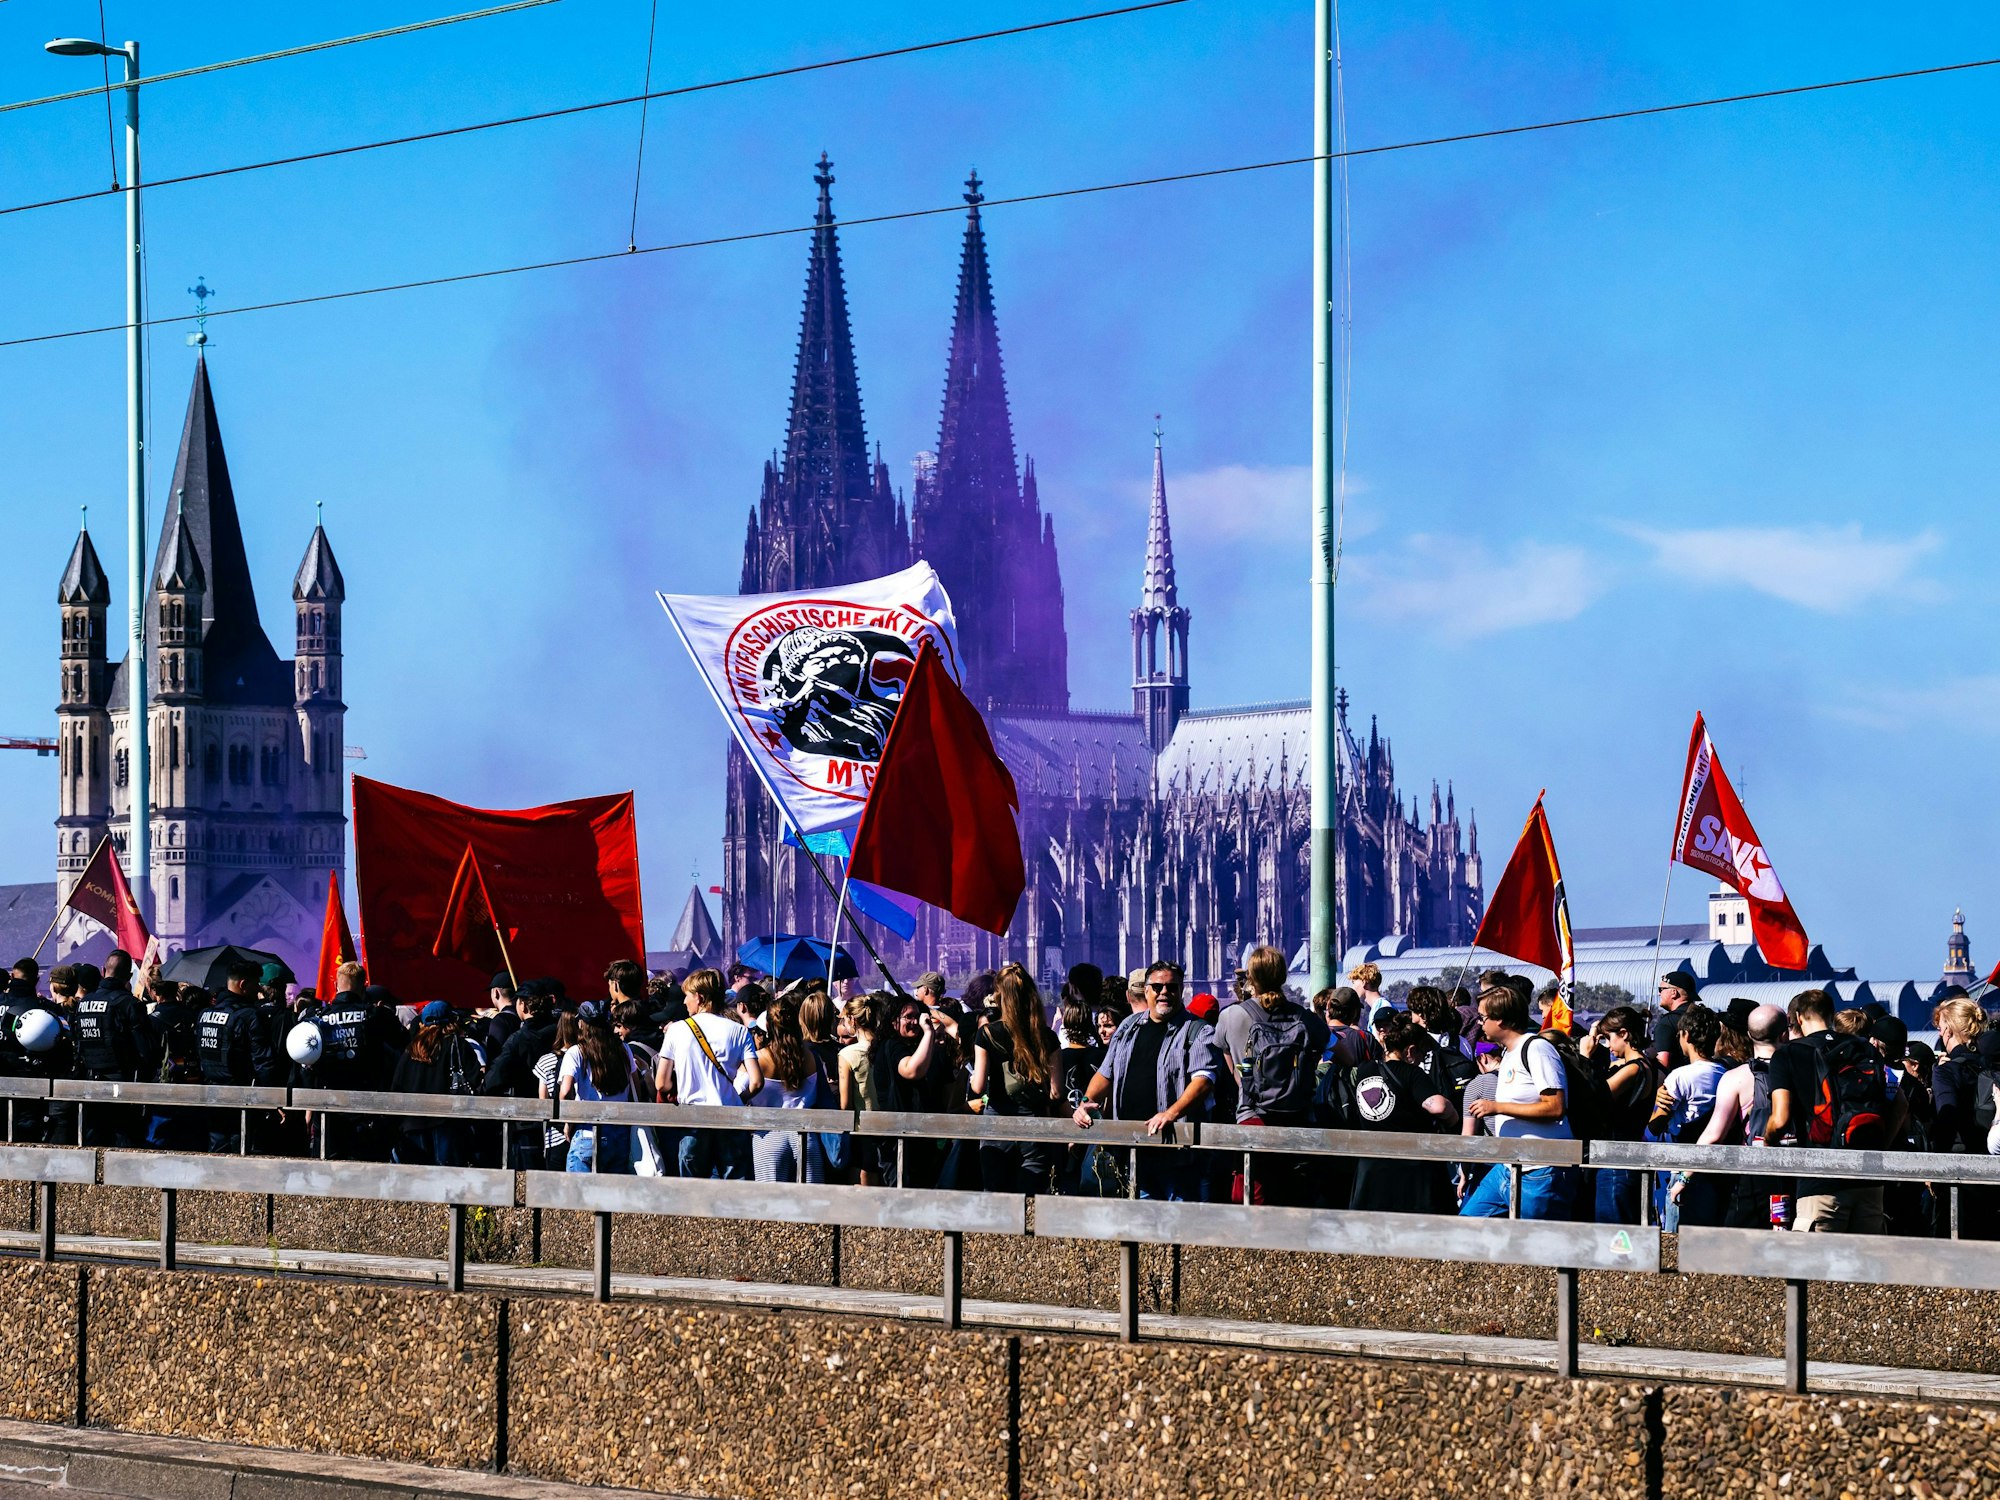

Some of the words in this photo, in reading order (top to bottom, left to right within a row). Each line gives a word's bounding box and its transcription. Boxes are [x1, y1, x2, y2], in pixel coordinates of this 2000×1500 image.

[736, 608, 865, 704] ANTIFASCHISTISCHE
[869, 610, 945, 662] AKTIO
[826, 759, 878, 792] M'G
[1689, 848, 1726, 869] SOZIALISTISCHE
[85, 881, 116, 904] KOMM
[78, 1000, 108, 1013] POLIZEI
[80, 1018, 97, 1028] NRW
[199, 1011, 230, 1025] POLIZEI
[81, 1028, 101, 1038] 31431
[202, 1026, 218, 1038] NRW
[200, 1038, 218, 1049] 31432
